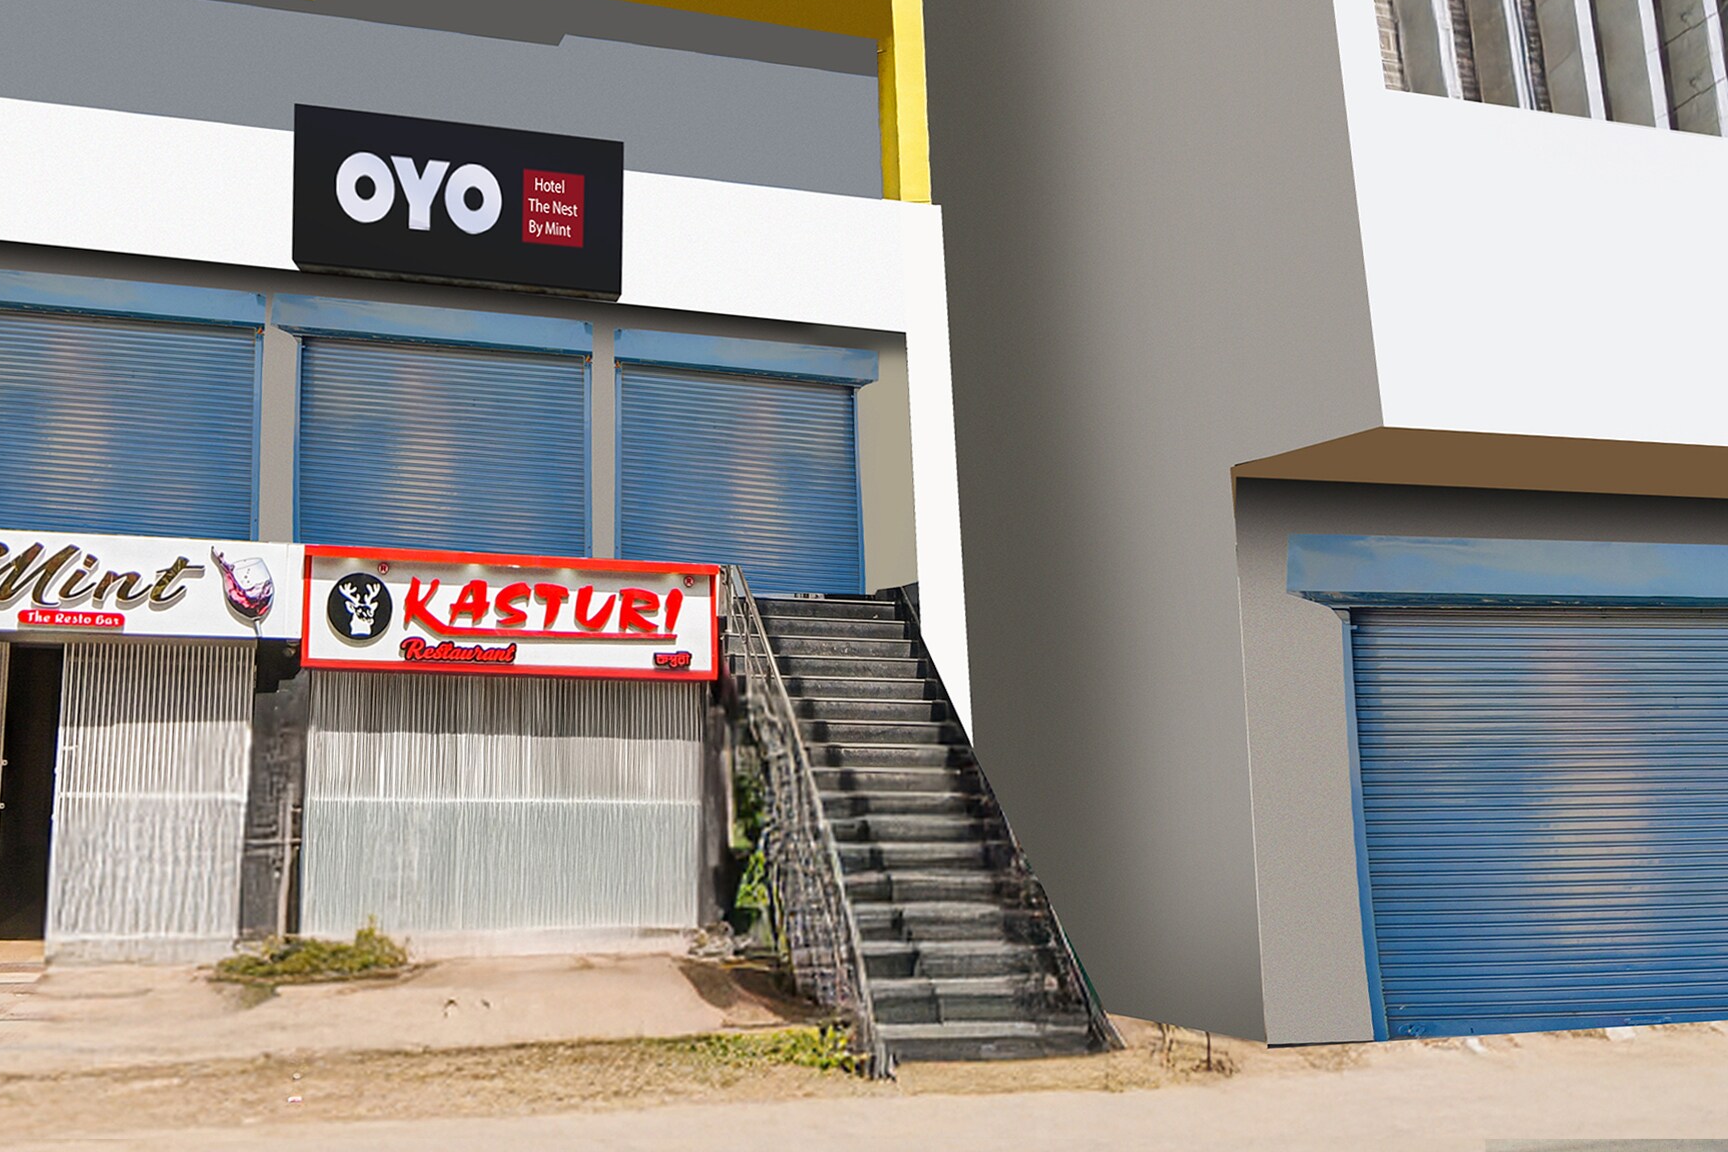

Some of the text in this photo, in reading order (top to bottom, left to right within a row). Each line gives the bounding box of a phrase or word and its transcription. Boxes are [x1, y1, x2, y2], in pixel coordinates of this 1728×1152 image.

[335, 150, 503, 235] OYO
[534, 176, 565, 194] Hotel
[528, 197, 579, 217] The Nest
[528, 218, 572, 238] By Mint
[402, 575, 684, 639] KASTURI
[27, 609, 120, 626] The Resto Bar
[400, 636, 518, 664] Restaurant
